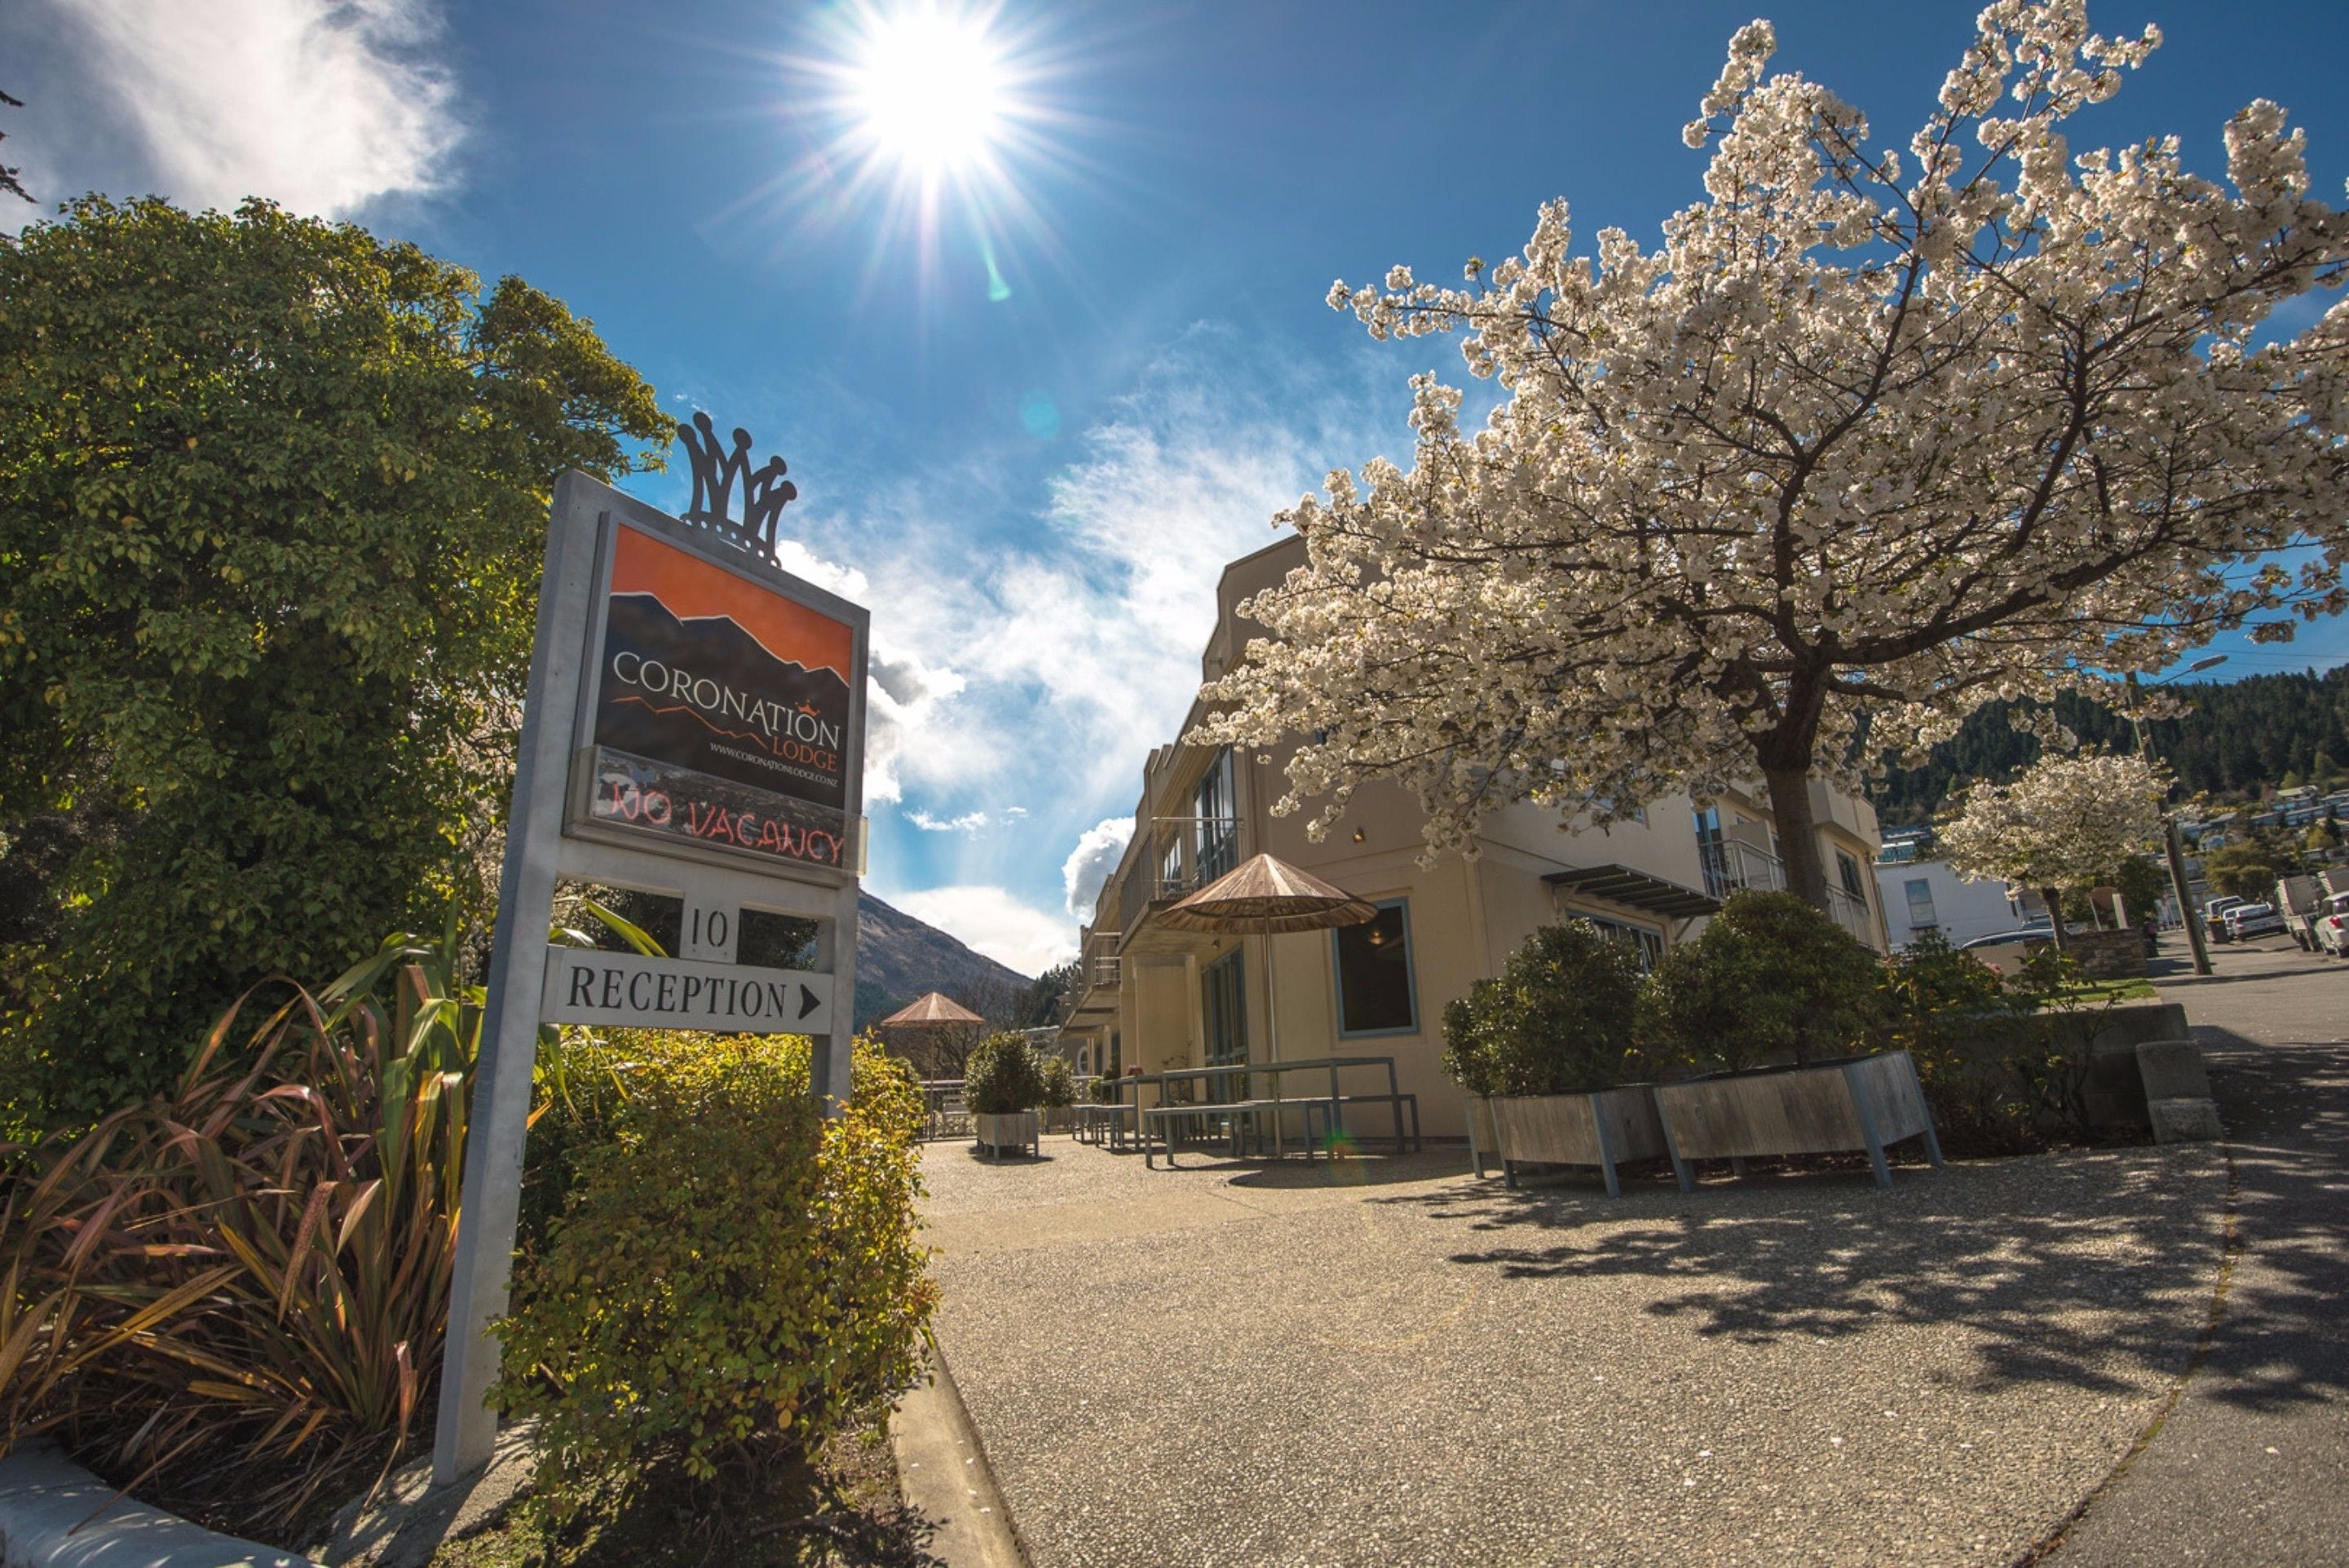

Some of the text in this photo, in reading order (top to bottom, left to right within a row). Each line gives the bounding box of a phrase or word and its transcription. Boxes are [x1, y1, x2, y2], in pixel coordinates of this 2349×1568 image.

[613, 651, 840, 750] CORONATION
[771, 735, 837, 772] LODGE
[611, 783, 845, 864] NO VACANCY
[691, 908, 727, 947] 10
[566, 965, 787, 1018] RECEPTION
